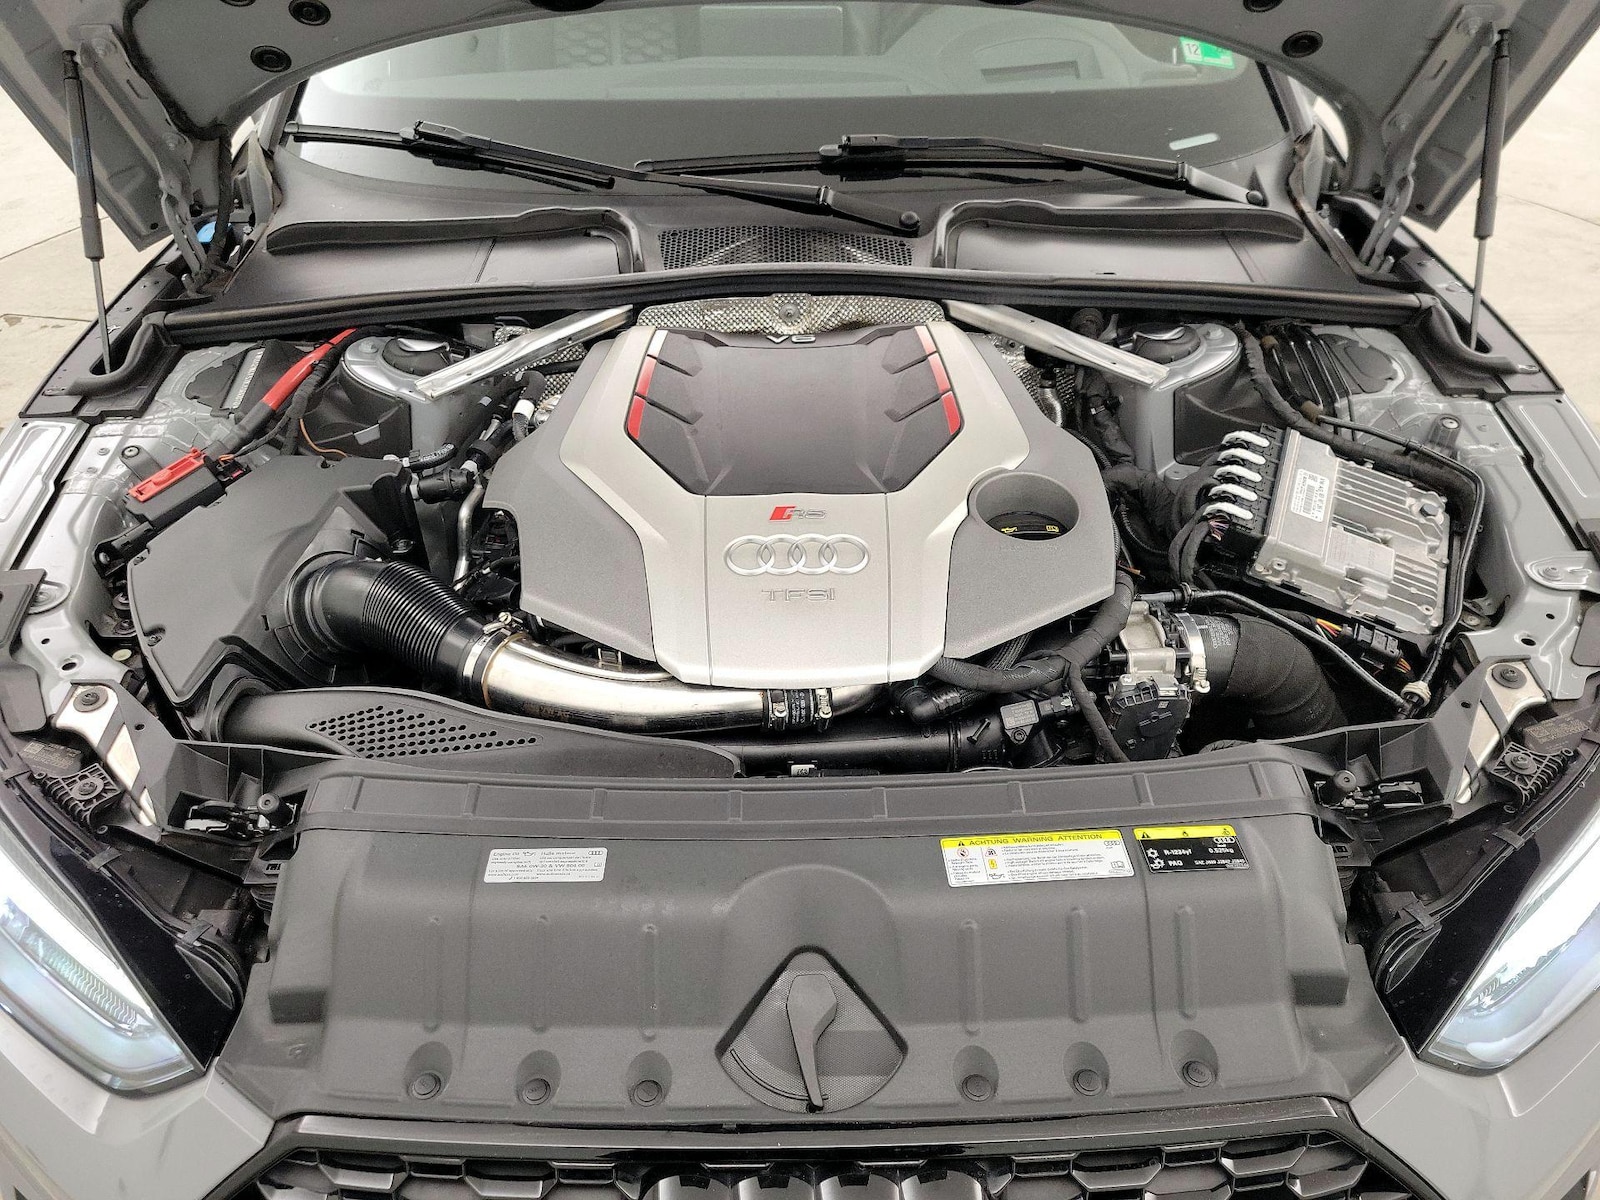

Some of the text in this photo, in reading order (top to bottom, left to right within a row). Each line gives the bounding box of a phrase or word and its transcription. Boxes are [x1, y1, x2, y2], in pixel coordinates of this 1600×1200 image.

[1185, 43, 1199, 55] 12
[761, 588, 835, 602] TFSI
[969, 833, 1103, 846] ACHTUNG WARNING ATTENTION
